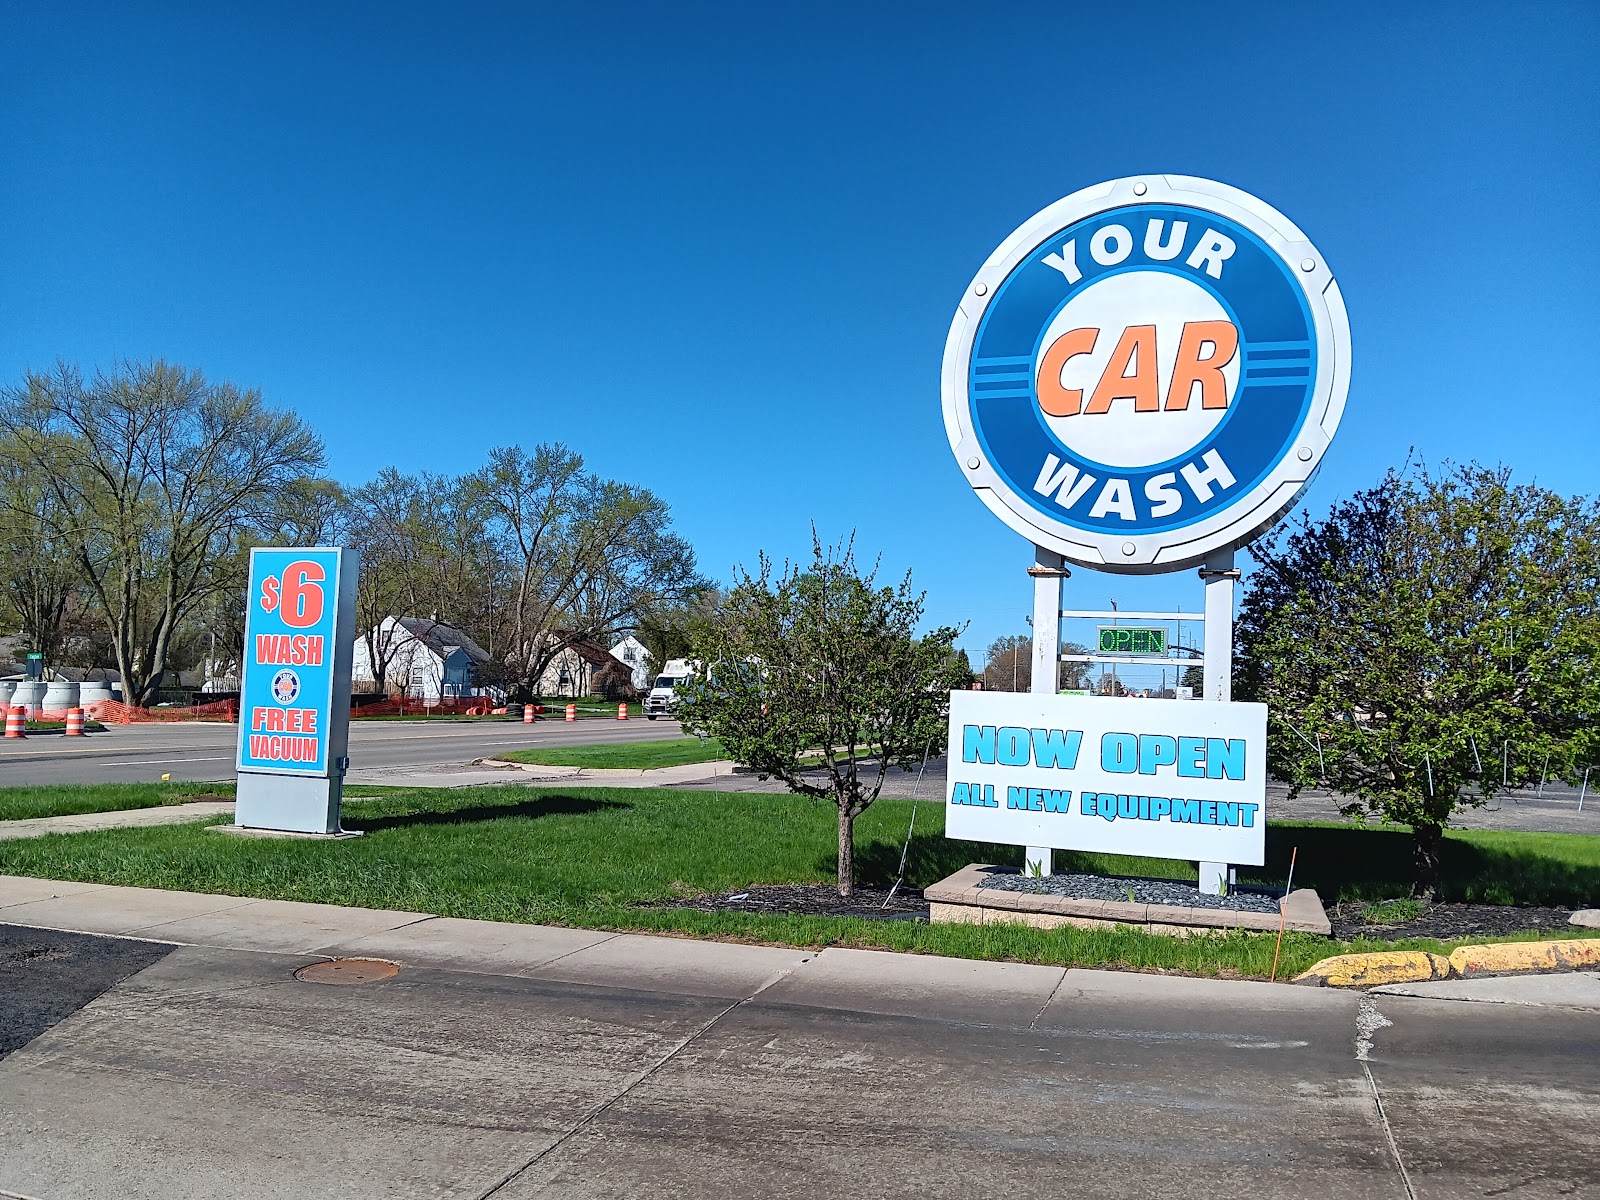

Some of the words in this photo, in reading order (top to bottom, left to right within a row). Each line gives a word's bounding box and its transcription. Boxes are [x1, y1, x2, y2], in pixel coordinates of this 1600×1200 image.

[1041, 219, 1236, 285] YOUR
[1036, 320, 1239, 417] CAR
[1033, 448, 1237, 521] WASH
[261, 560, 325, 628] $6
[256, 634, 324, 666] WASH
[1100, 629, 1164, 653] OPEN
[252, 706, 317, 734] FREE
[249, 734, 318, 763] VACUUM
[962, 724, 1083, 769] NOW
[1100, 732, 1246, 780] OPEN
[951, 782, 998, 807] ALL
[1007, 786, 1072, 813] NEW
[1081, 791, 1258, 827] EQUIPMENT
